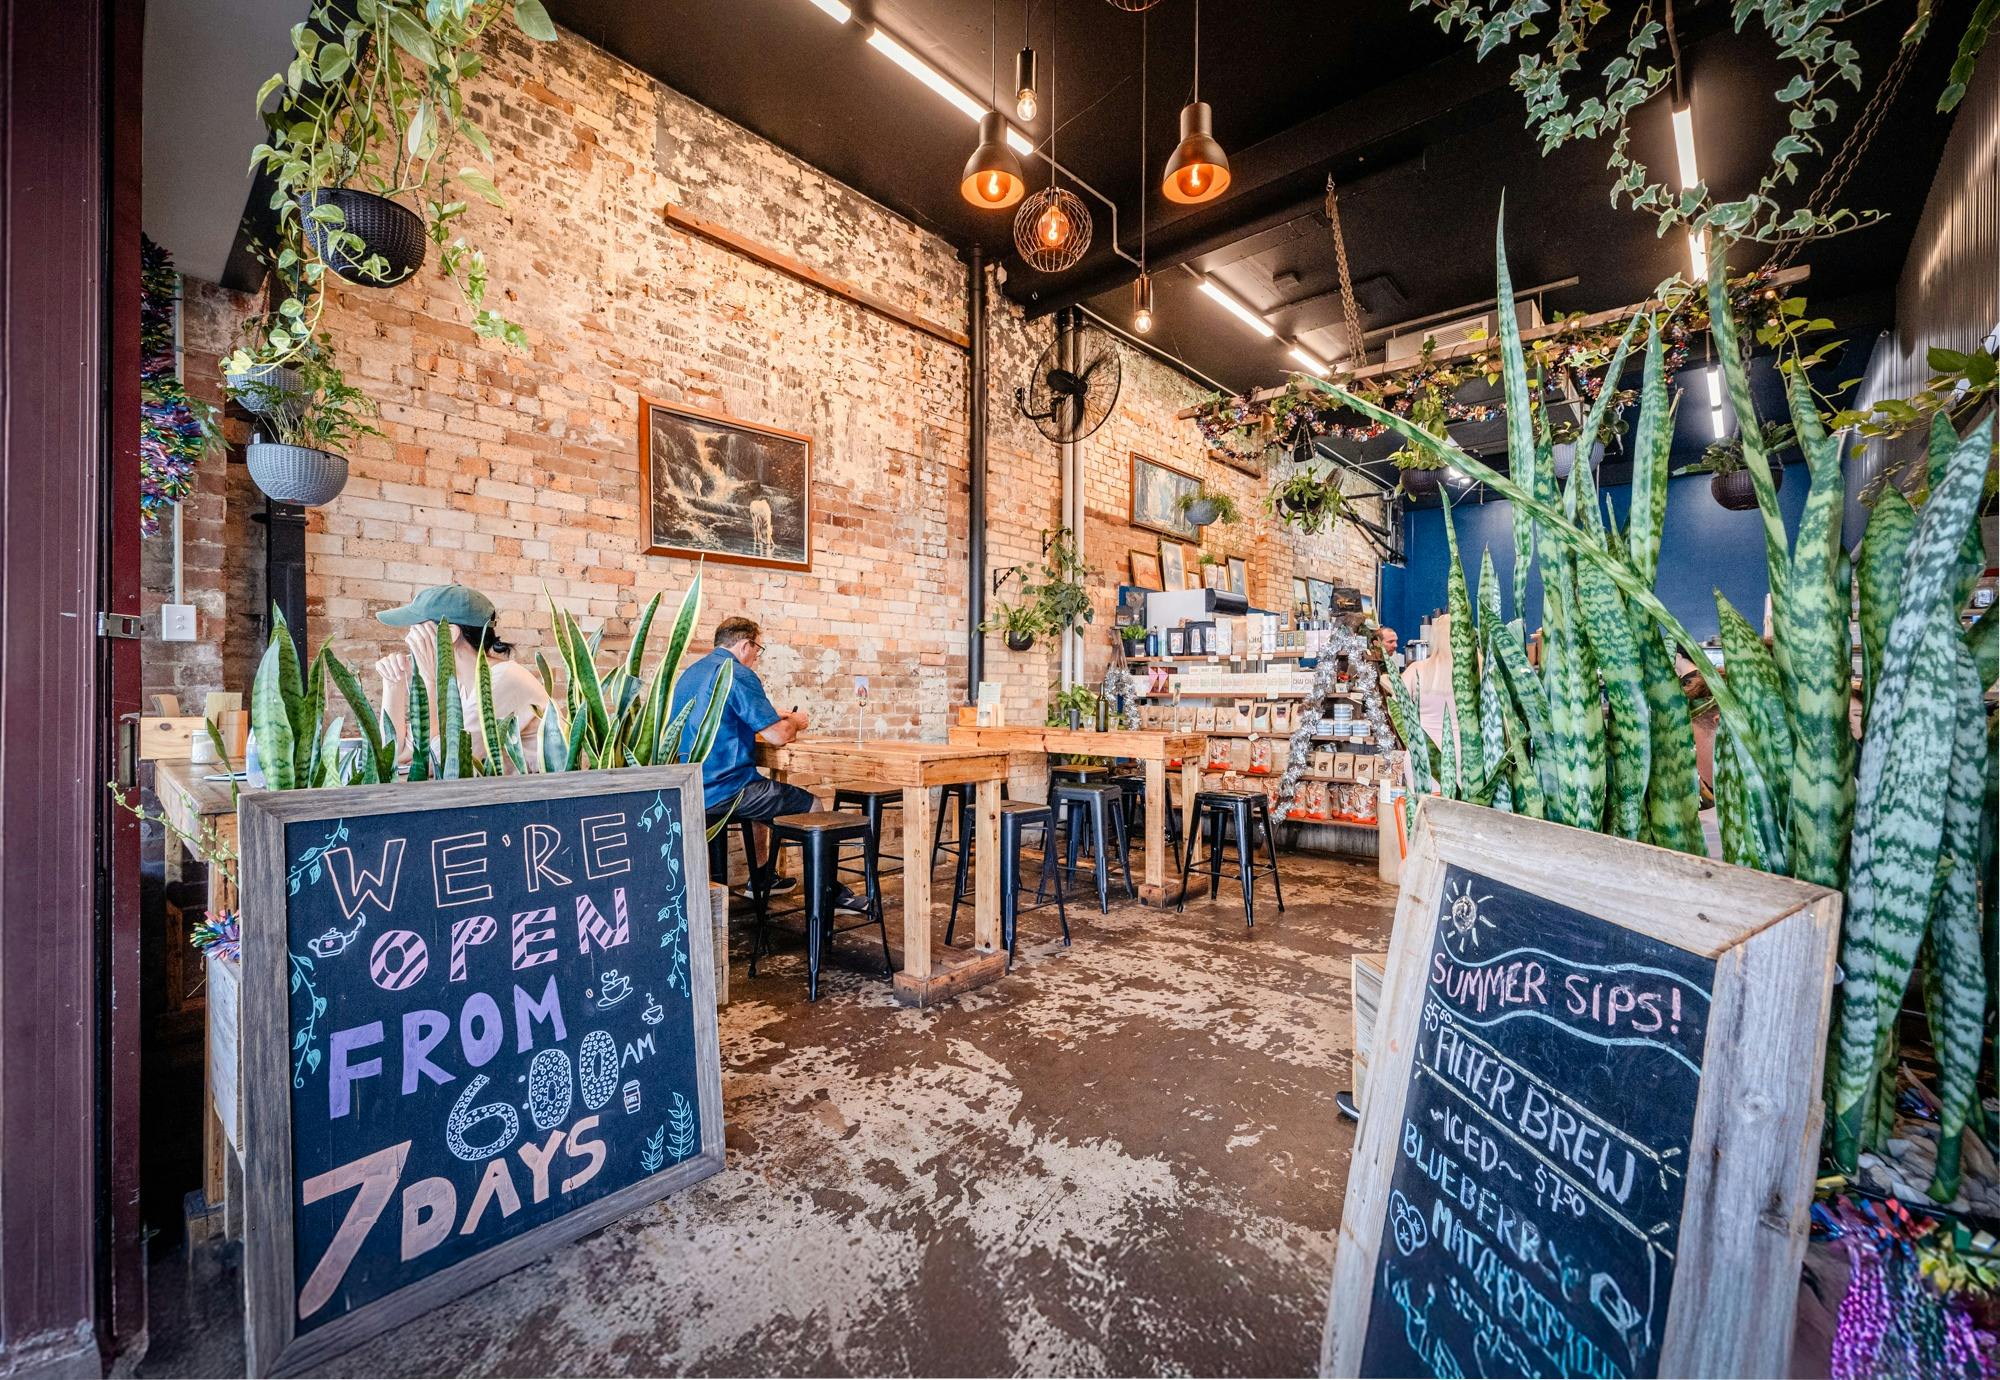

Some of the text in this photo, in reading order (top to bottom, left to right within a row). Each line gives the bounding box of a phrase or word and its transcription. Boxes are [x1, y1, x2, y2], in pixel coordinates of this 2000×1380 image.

[323, 812, 632, 919] WE'RE
[370, 887, 629, 990] OPEN
[1432, 952, 1682, 1035] SUMMER SIPS!
[328, 975, 567, 1120] FROM
[621, 1032, 656, 1068] AM
[1435, 1025, 1636, 1205] FILTER BREW
[299, 1115, 607, 1320] 7 DAYS
